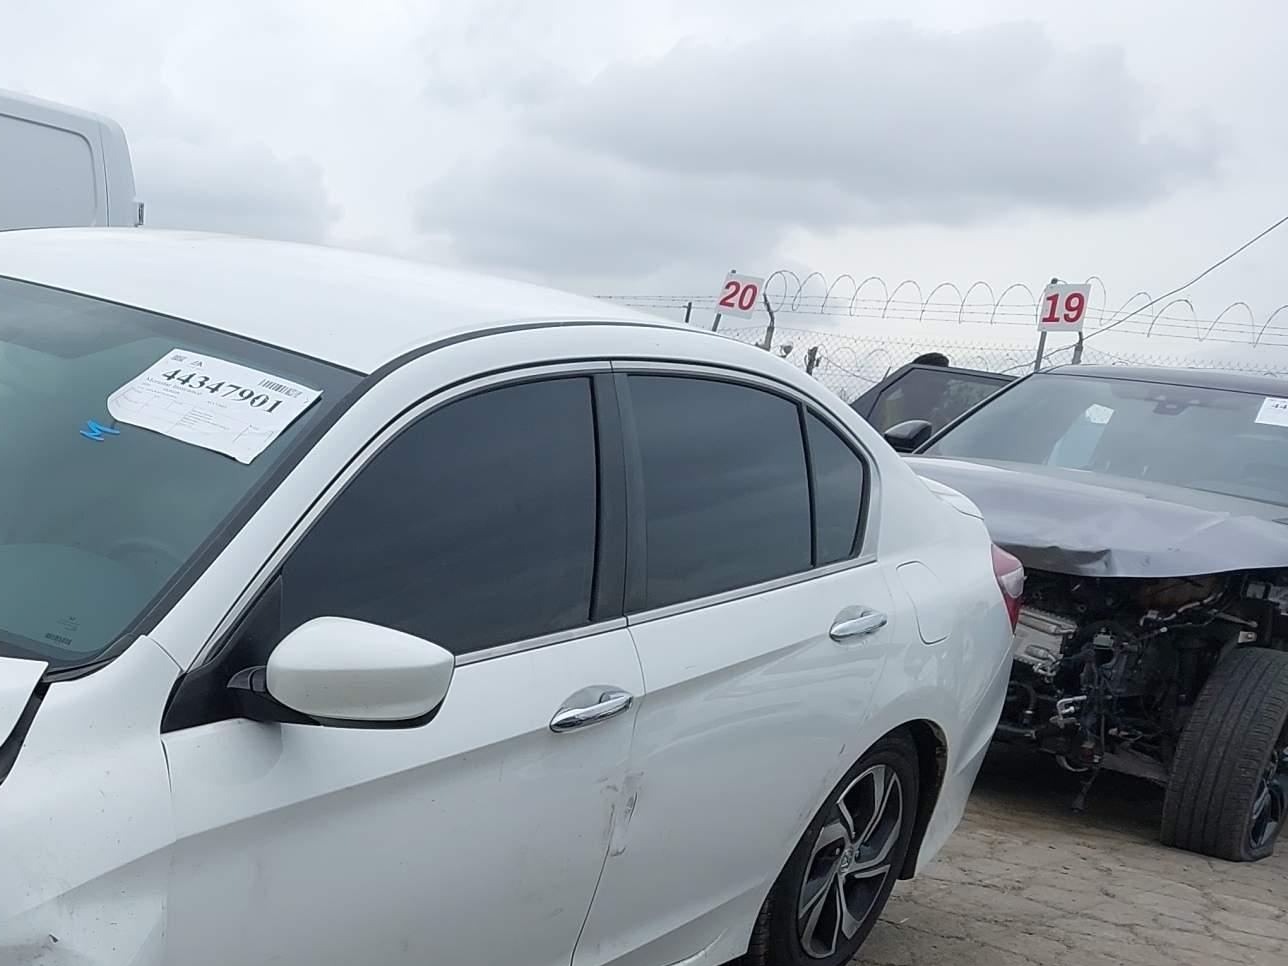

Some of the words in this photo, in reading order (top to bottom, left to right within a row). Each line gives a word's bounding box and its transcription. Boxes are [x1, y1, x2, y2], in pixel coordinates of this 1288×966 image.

[719, 280, 758, 311] 20
[1041, 292, 1085, 323] 19
[161, 369, 284, 414] 44347901
